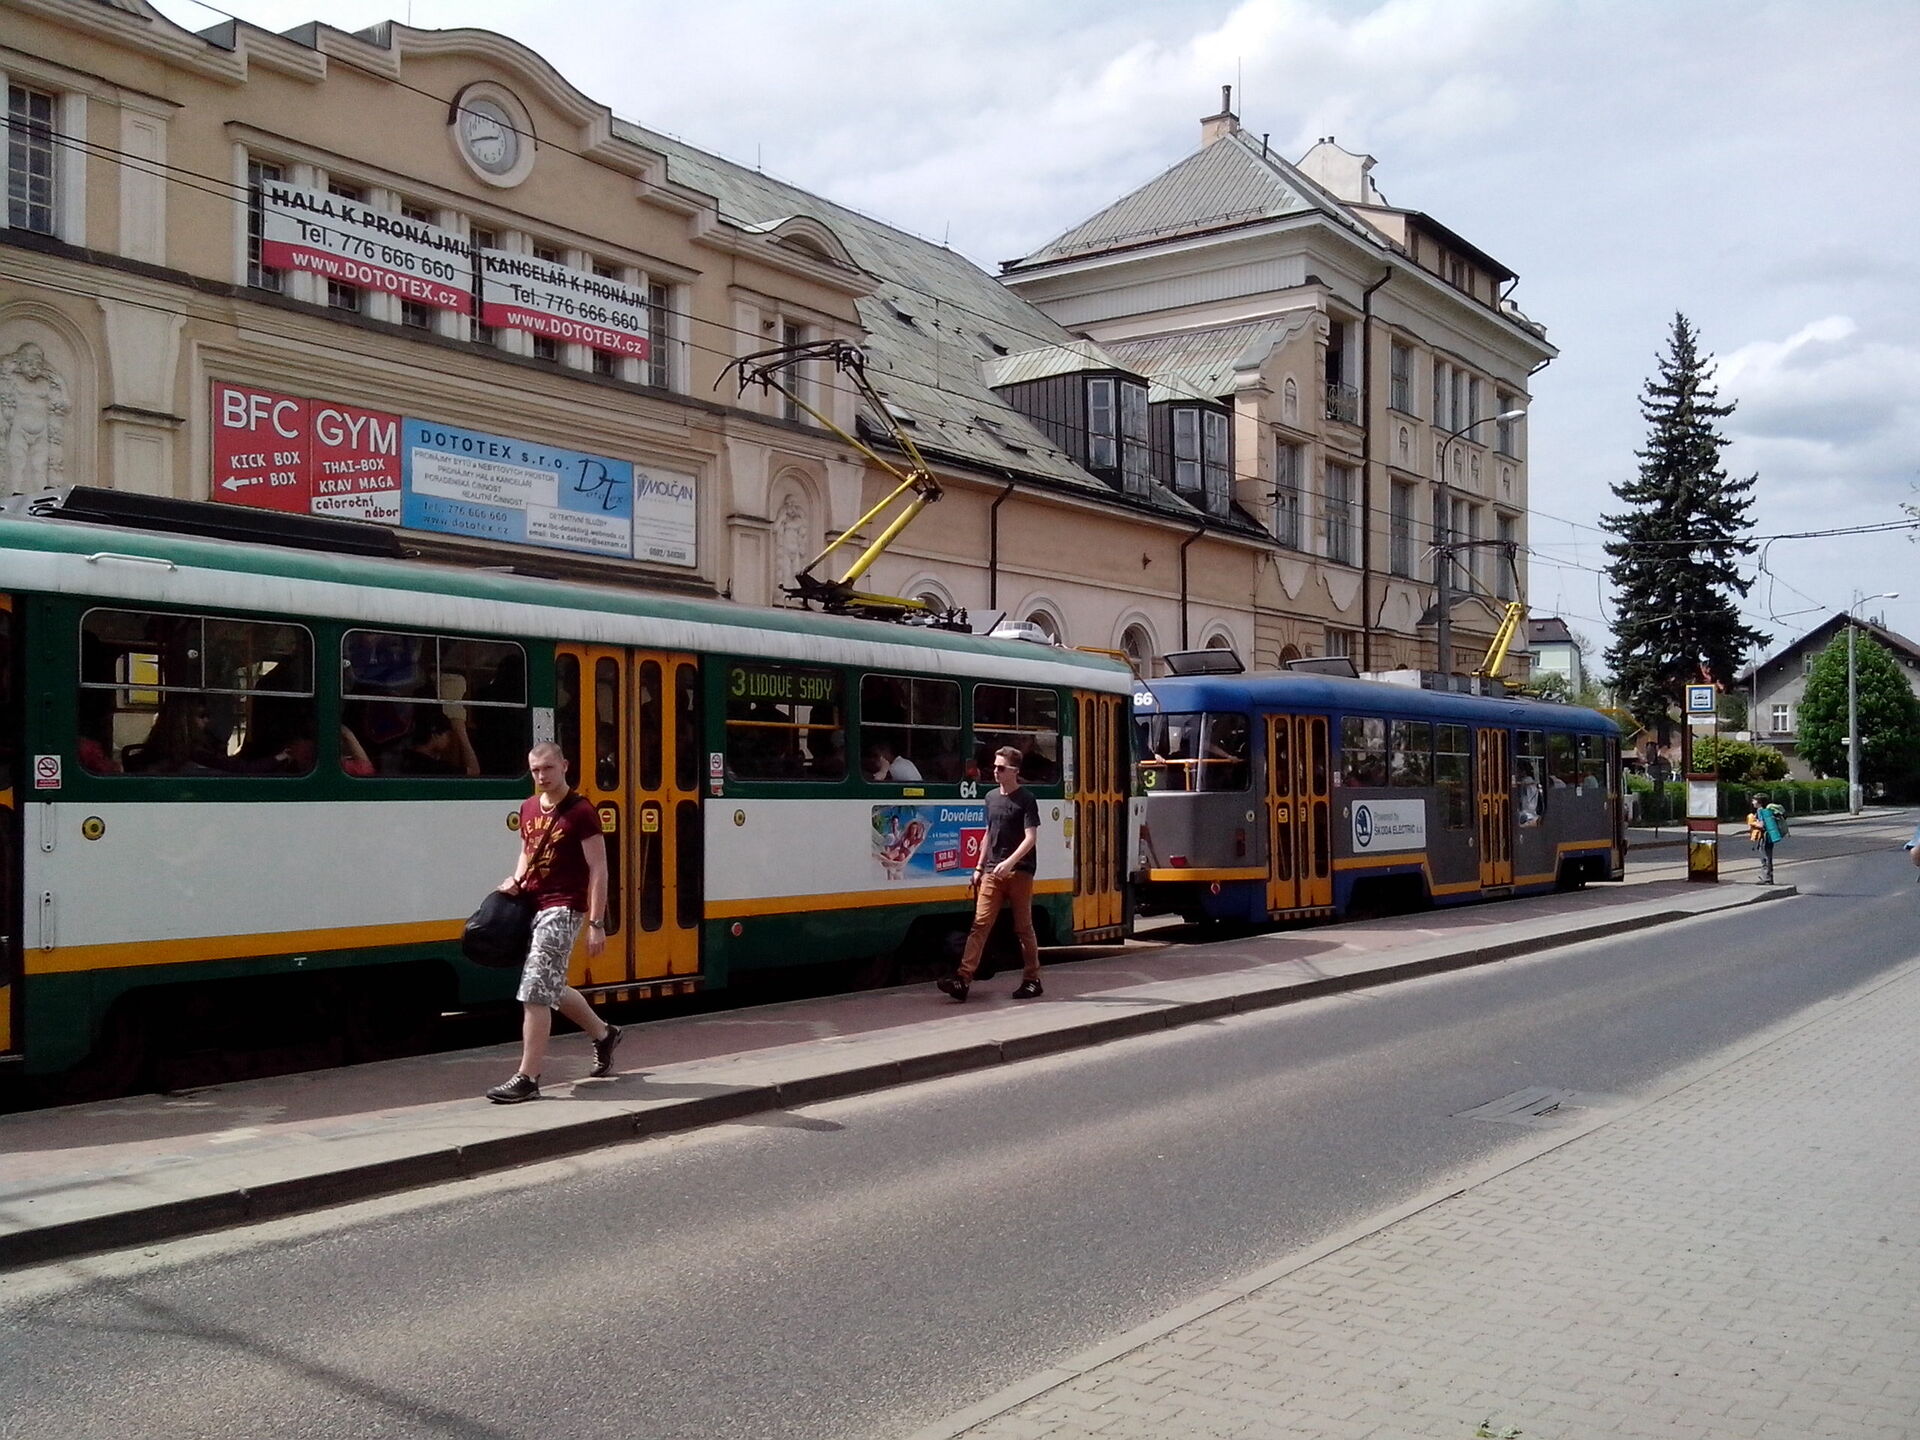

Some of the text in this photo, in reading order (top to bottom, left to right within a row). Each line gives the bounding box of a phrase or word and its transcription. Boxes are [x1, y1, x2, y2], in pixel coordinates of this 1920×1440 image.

[272, 187, 470, 259] HALA K PRONÁJMU
[297, 219, 454, 281] Tel. 776 666 660
[292, 252, 458, 306] www.DOTOTEX.cz
[486, 256, 566, 288] KANCELÁŘ
[570, 275, 580, 292] K
[510, 283, 638, 331] Tel. 776 666 660
[507, 312, 643, 354] www.DOTOTEX.cz
[223, 389, 299, 438] BFC
[316, 409, 397, 456] GYM
[231, 451, 301, 469] KICK BOX
[421, 429, 569, 470] DOTOTEX s.r.o.
[270, 472, 297, 486] BOX
[322, 458, 386, 475] THAI-BOX
[319, 475, 395, 494] KRAV MAGA
[316, 495, 374, 510] celoroční
[364, 505, 399, 518] nábor
[731, 668, 746, 696] 3
[799, 677, 832, 700] SADY
[1133, 692, 1153, 706] 66
[960, 781, 978, 798] 64
[1143, 769, 1156, 787] 3
[940, 808, 984, 822] Dovolená
